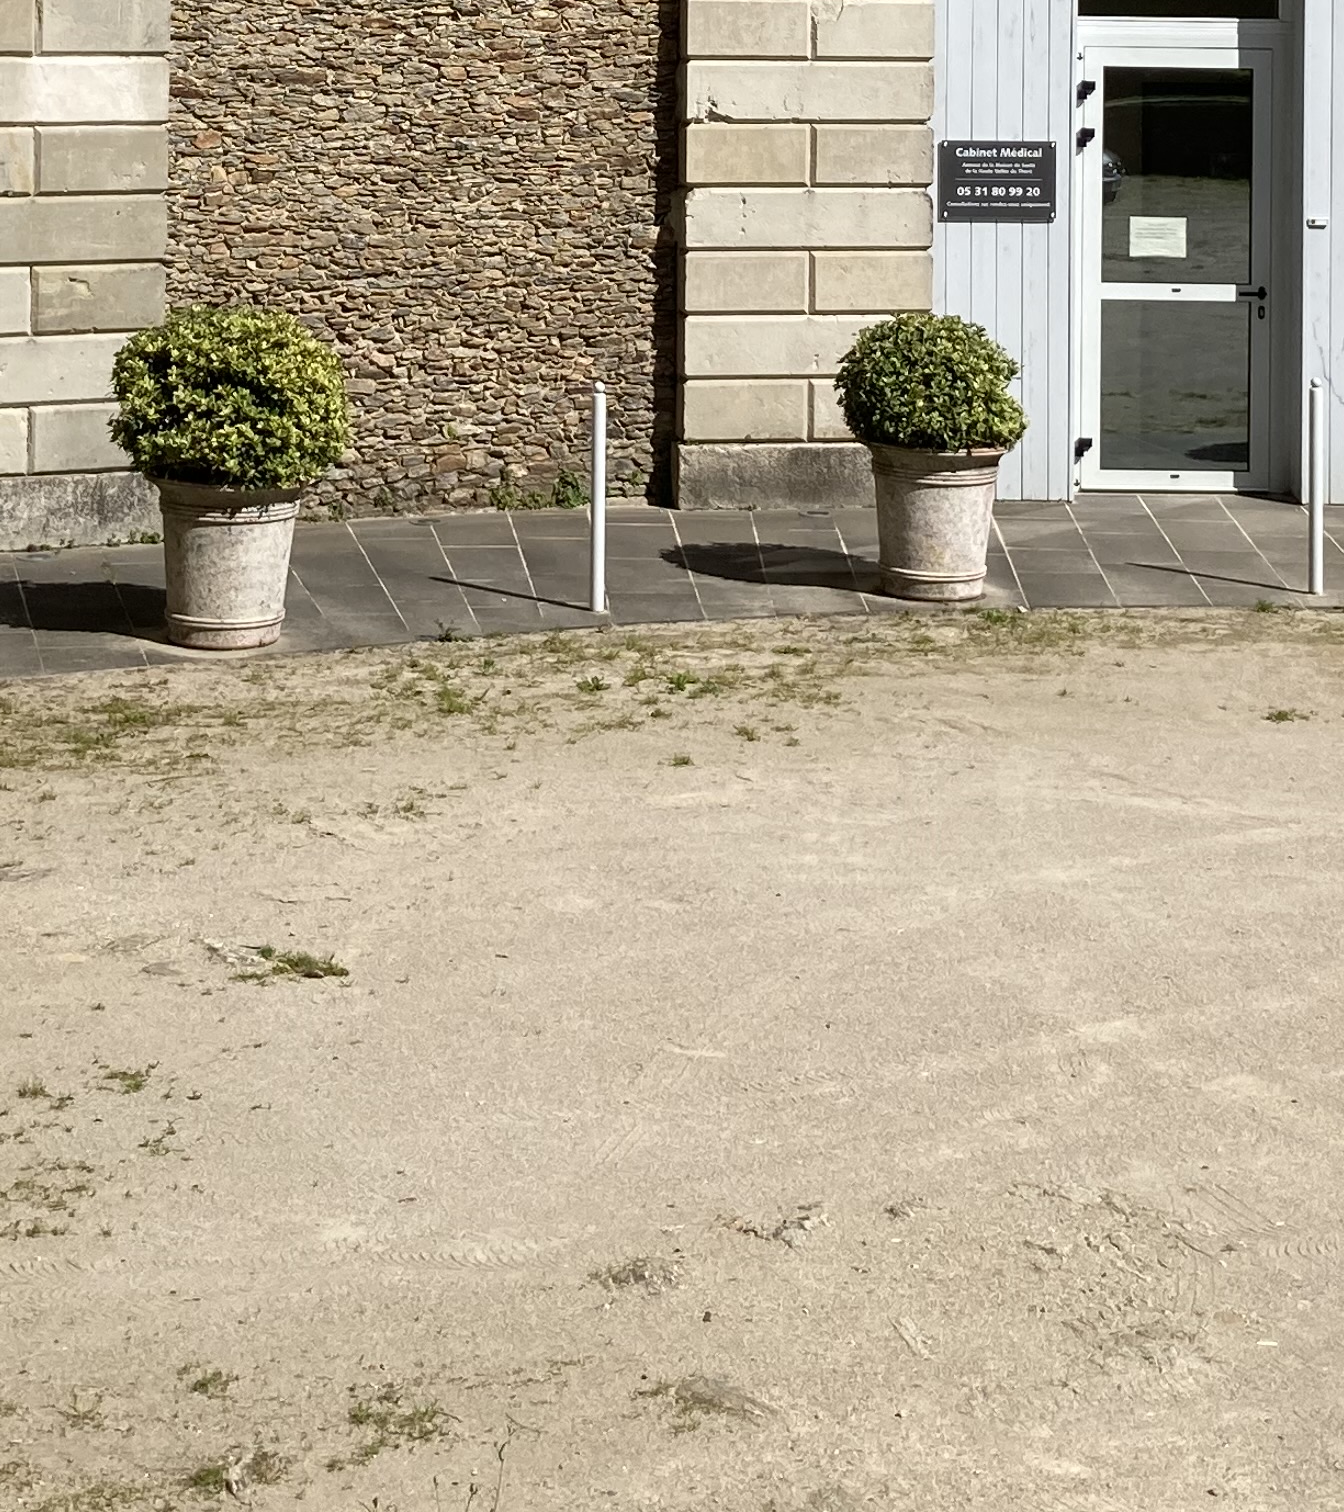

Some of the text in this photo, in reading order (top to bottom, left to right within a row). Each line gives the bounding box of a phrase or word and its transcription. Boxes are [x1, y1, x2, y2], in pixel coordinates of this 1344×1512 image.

[955, 147, 1043, 158] Cabinet Médical
[956, 186, 1041, 197] 05 31 80 99 20
